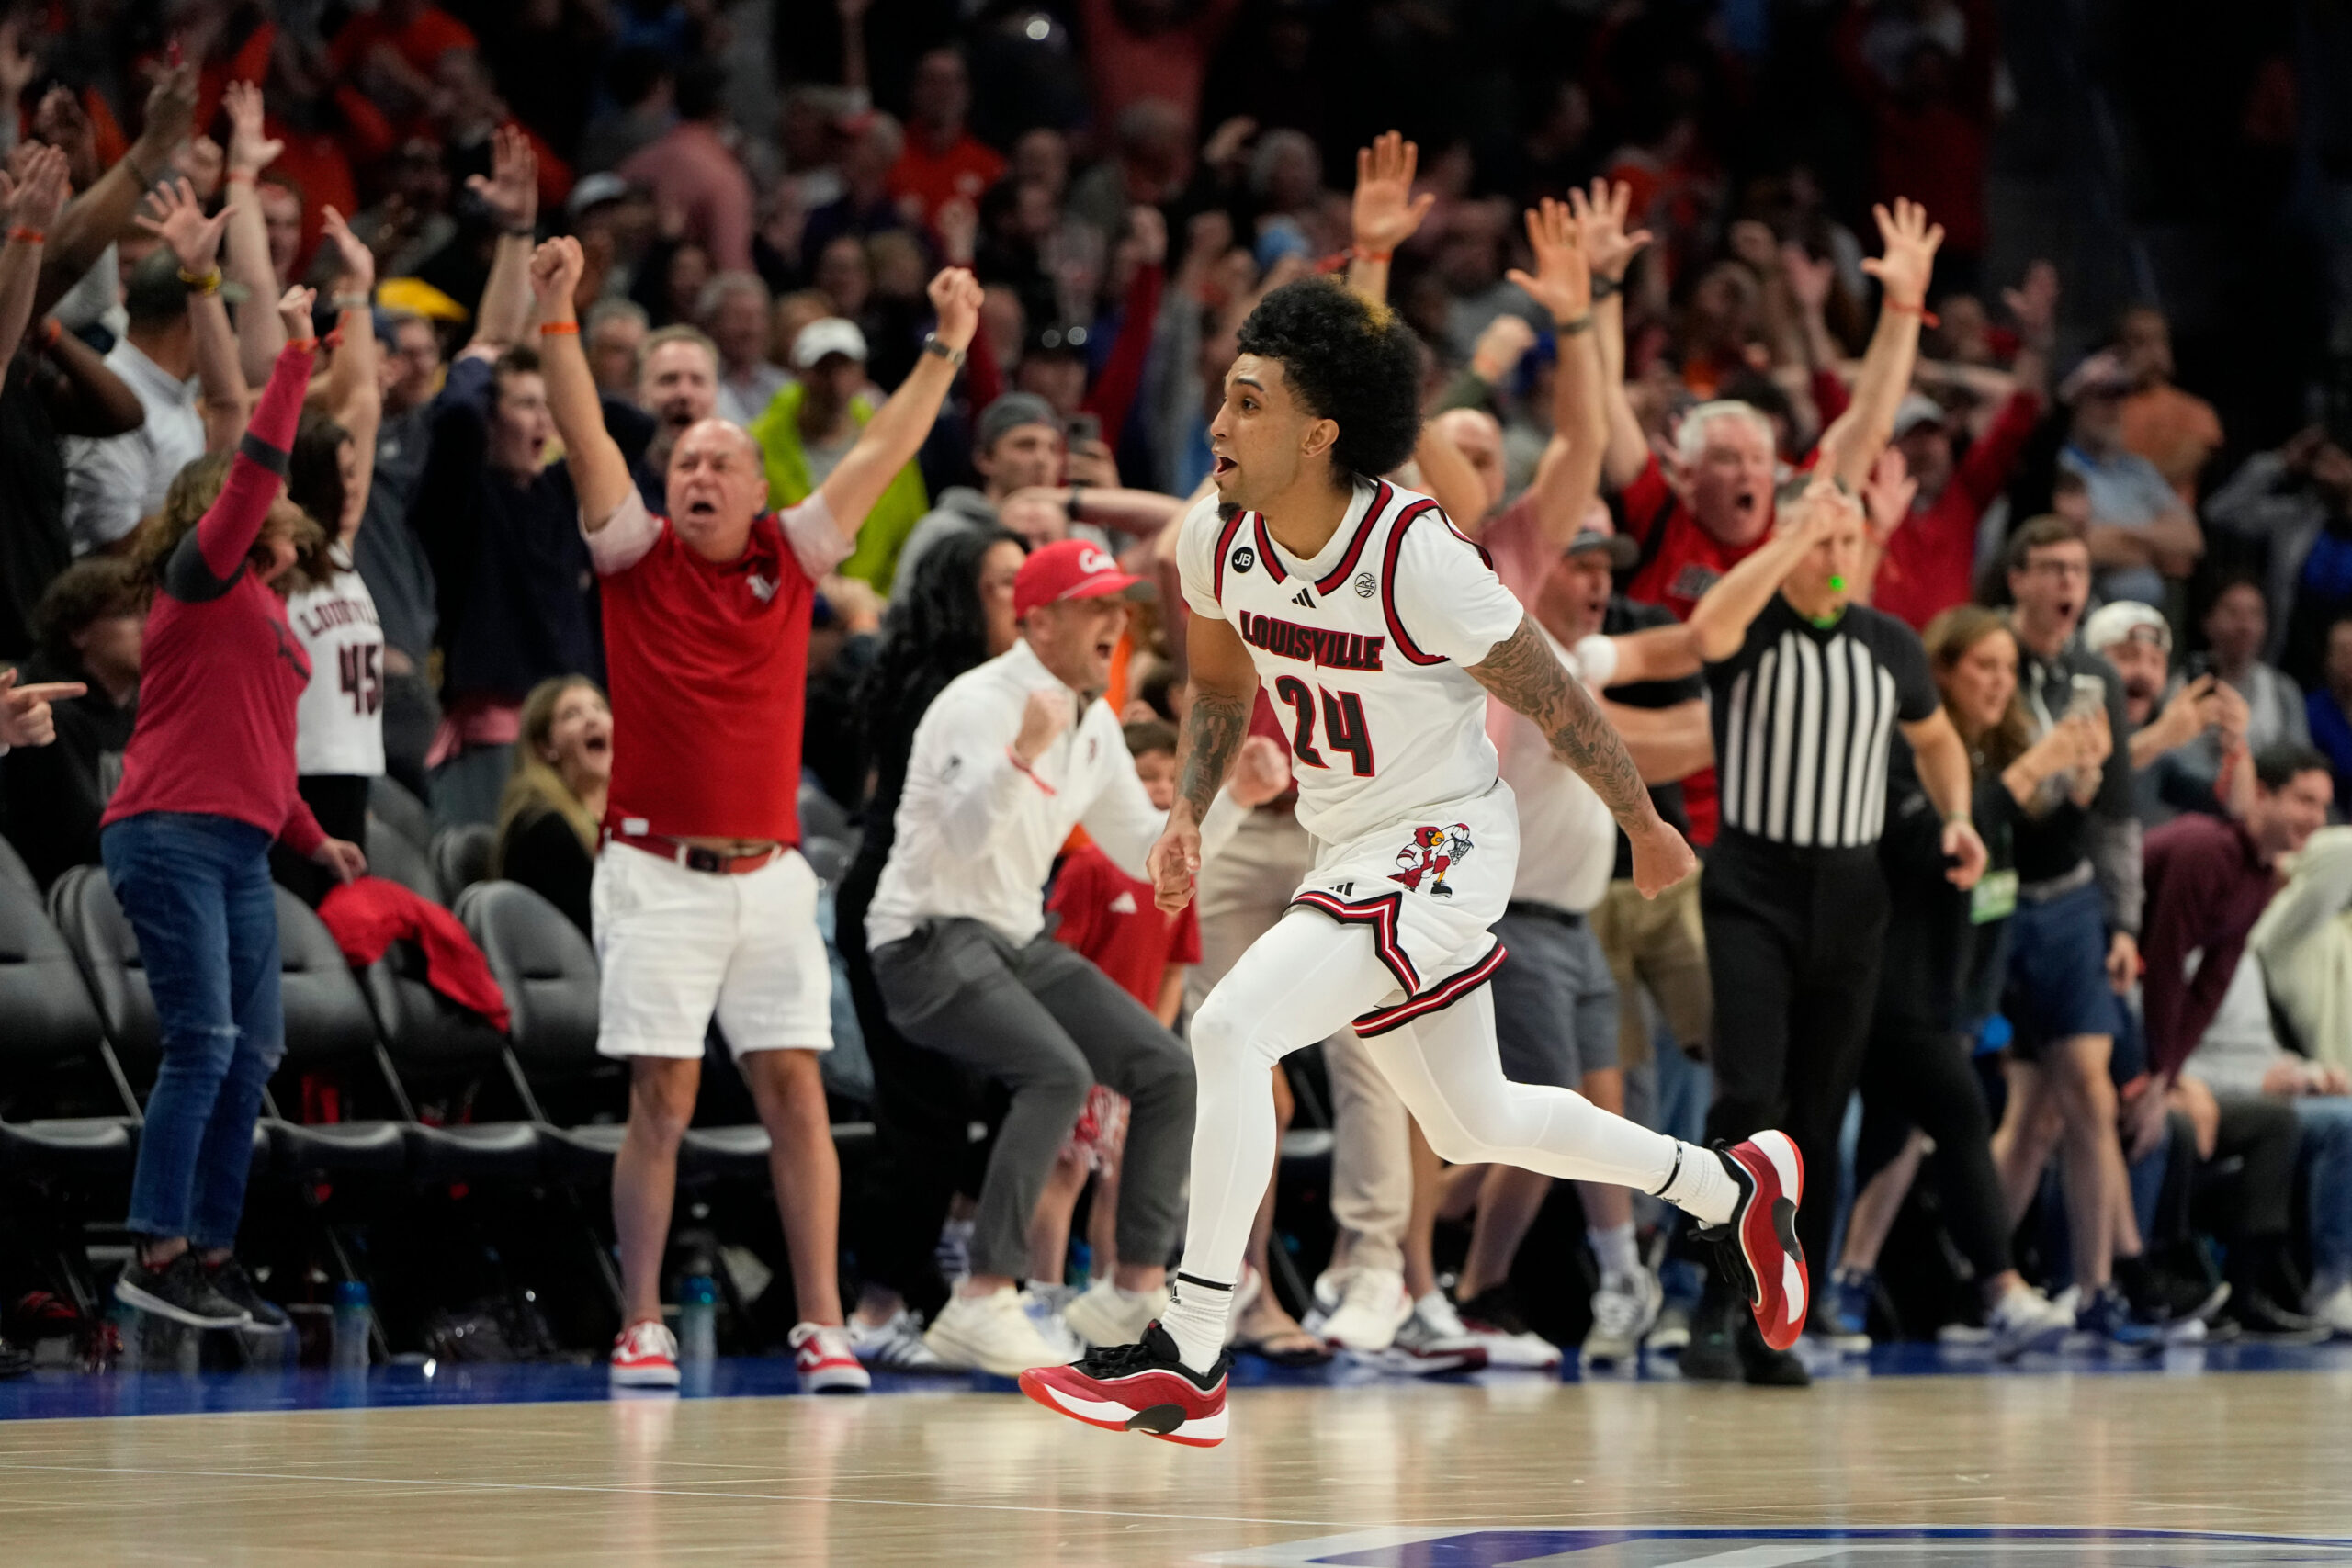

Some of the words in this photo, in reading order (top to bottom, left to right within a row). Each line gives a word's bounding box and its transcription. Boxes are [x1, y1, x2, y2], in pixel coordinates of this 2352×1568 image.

[1234, 552, 1252, 567] JB
[1355, 580, 1375, 589] ACC
[1240, 609, 1385, 671] LOUISVILLE
[338, 641, 383, 716] 45
[1274, 674, 1375, 778] 24
